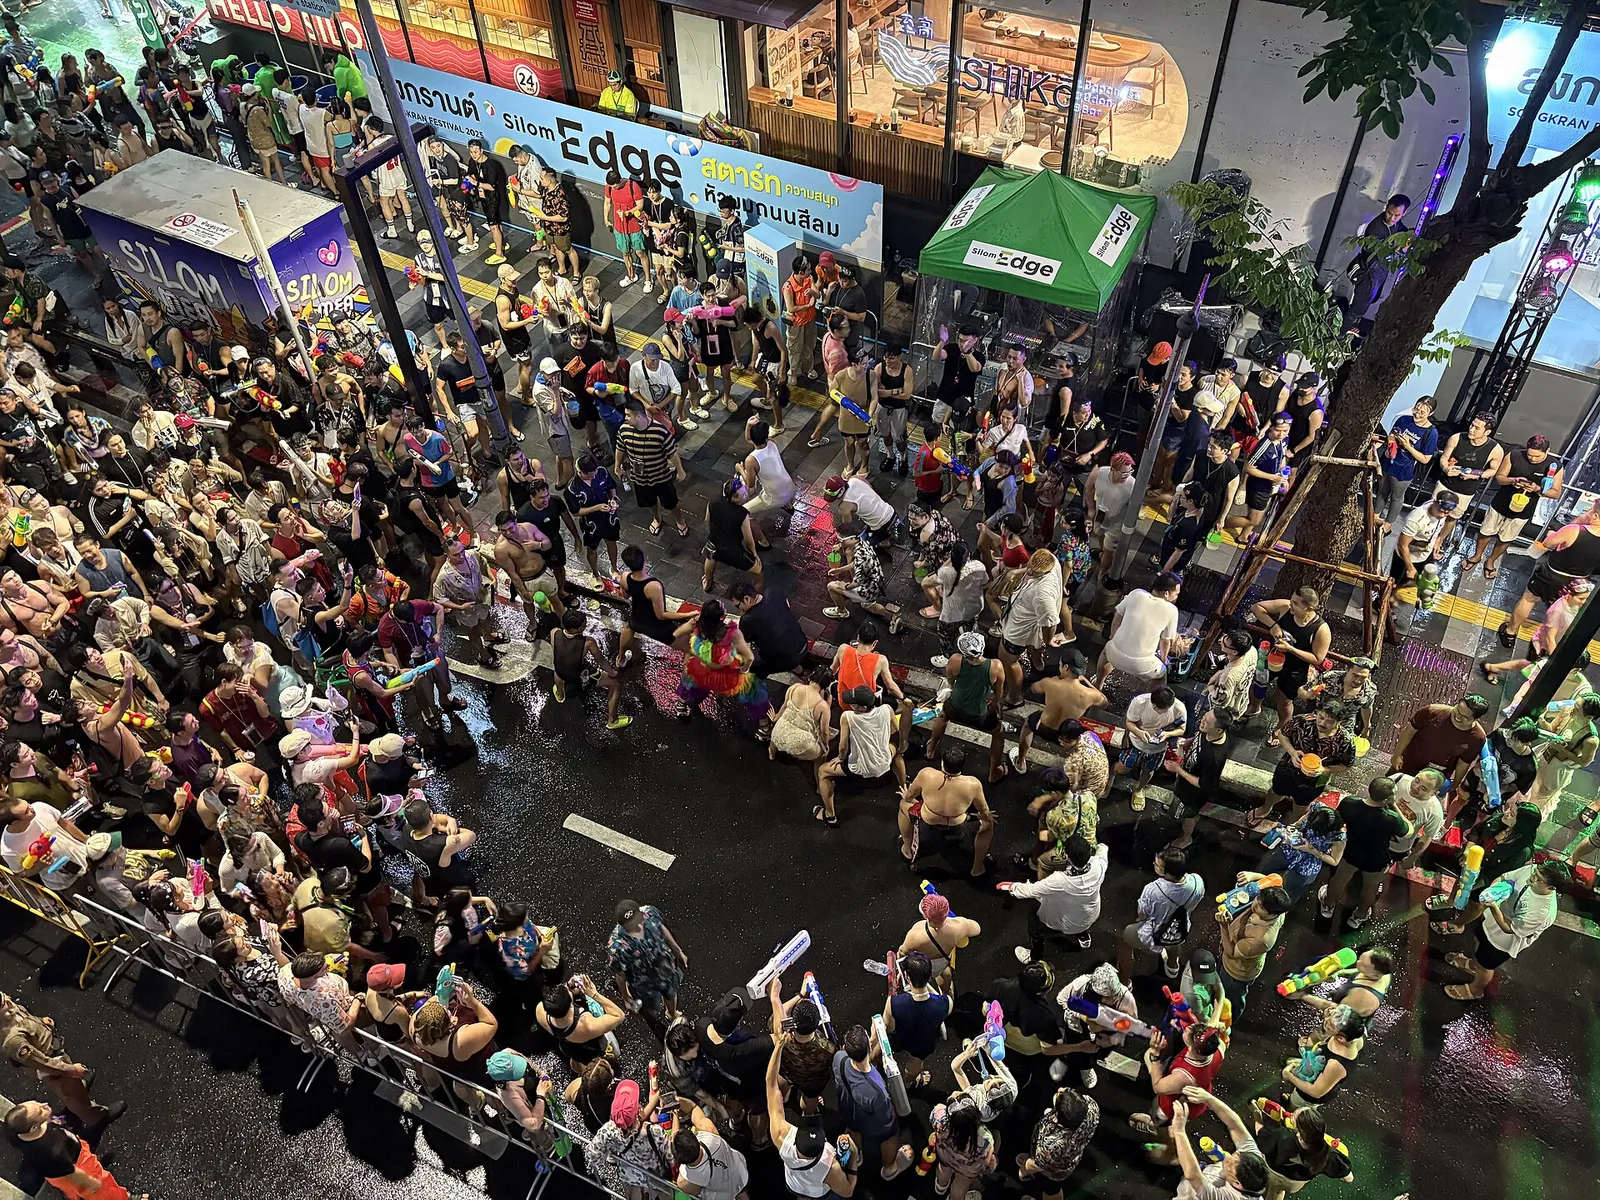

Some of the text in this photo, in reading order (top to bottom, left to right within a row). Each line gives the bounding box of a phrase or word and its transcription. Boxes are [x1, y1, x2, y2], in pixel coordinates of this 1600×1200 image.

[209, 0, 292, 33] HELLO
[518, 72, 535, 88] 24
[395, 79, 481, 122] งกรานต์
[1507, 106, 1590, 130] SOGKRAN
[429, 117, 465, 135] FESTIVAL
[465, 127, 485, 140] 2025
[502, 112, 683, 190] Silom Edge
[701, 156, 840, 209] สตาร์ท ความสนุก
[704, 183, 840, 238] หัวุมถนนสีลม
[1096, 210, 1132, 258] Silom Edge
[118, 238, 229, 310] SILOM
[971, 247, 1054, 278] Silom Edge
[286, 271, 354, 304] SILOM
